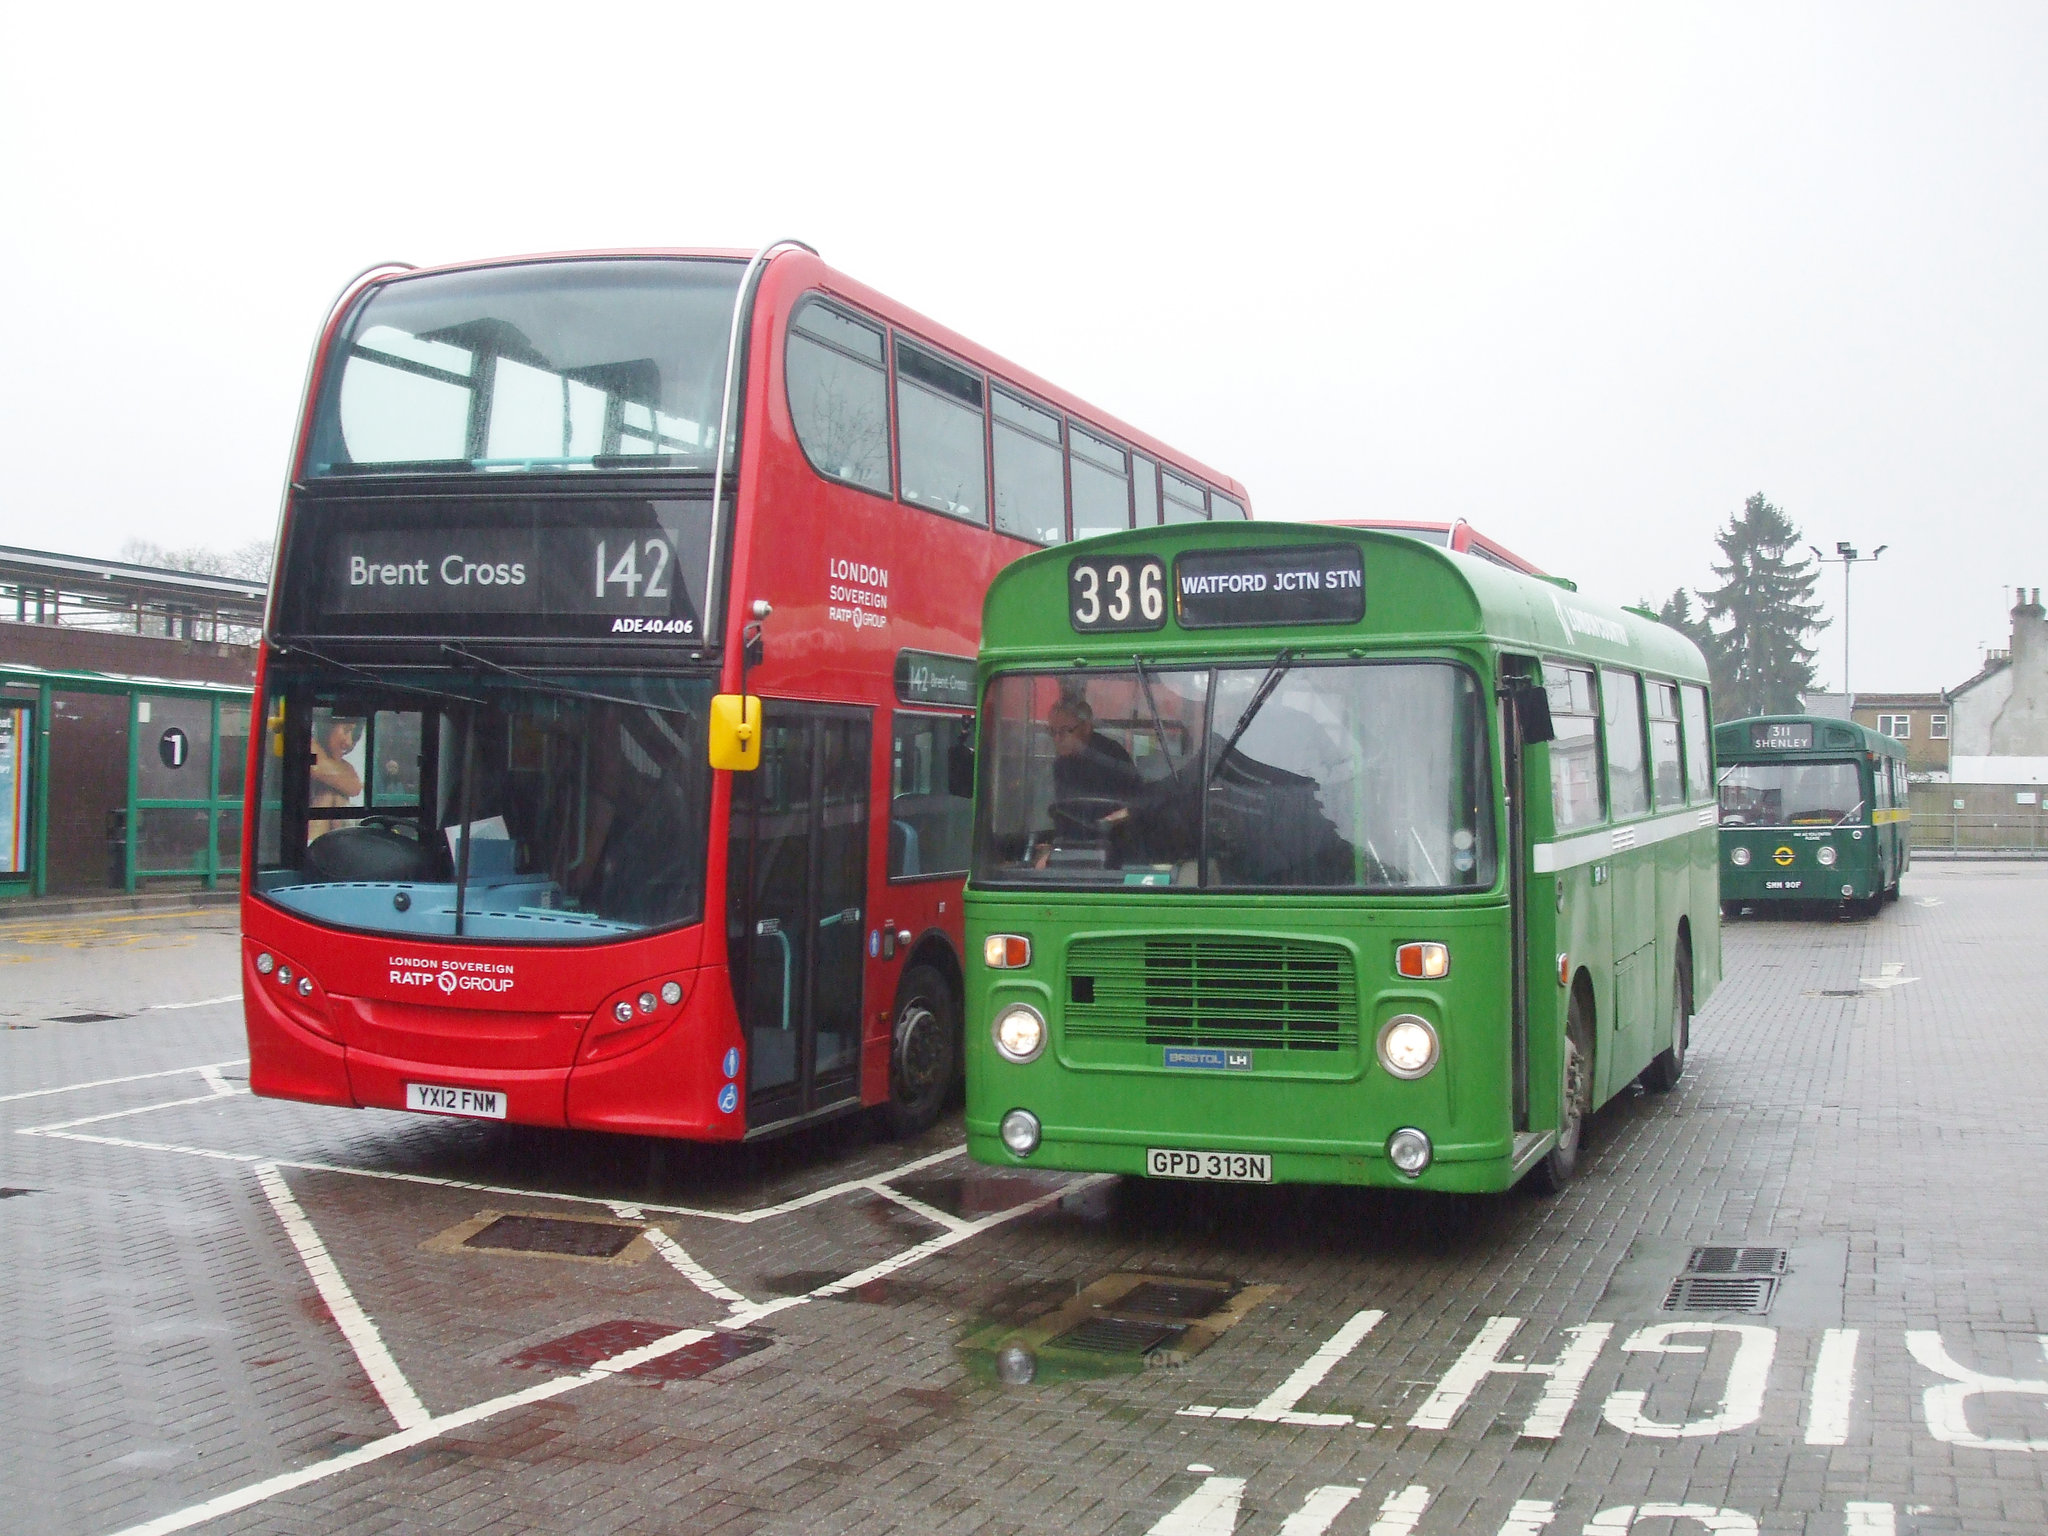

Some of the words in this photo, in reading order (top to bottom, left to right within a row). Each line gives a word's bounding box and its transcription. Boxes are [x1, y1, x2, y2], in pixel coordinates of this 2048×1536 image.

[349, 555, 429, 586] Brent
[439, 554, 527, 586] Cross
[594, 537, 669, 598] 142
[830, 558, 888, 588] LONDON
[1073, 563, 1164, 624] 336
[1181, 573, 1267, 595] WATFORD
[1273, 571, 1320, 592] JCTN
[1325, 569, 1362, 590] STN
[829, 585, 888, 609] SOVEREIGN
[611, 618, 694, 635] ADE40406
[829, 607, 852, 623] RATP
[862, 612, 887, 628] GROUP
[909, 665, 928, 692] 142
[1755, 738, 1808, 748] SHENLEY
[1772, 726, 1790, 737] 311
[170, 734, 182, 766] 1
[389, 956, 438, 969] LONDON
[441, 960, 514, 974] SOVEREIGN
[389, 970, 434, 986] RATP
[459, 976, 514, 992] GROUP
[1169, 1052, 1222, 1064] BRISTOL
[1229, 1055, 1247, 1066] LH
[419, 1086, 456, 1109] YX12
[462, 1091, 496, 1113] FNM
[1153, 1152, 1200, 1175] GPD
[1207, 1155, 1265, 1179] 313N
